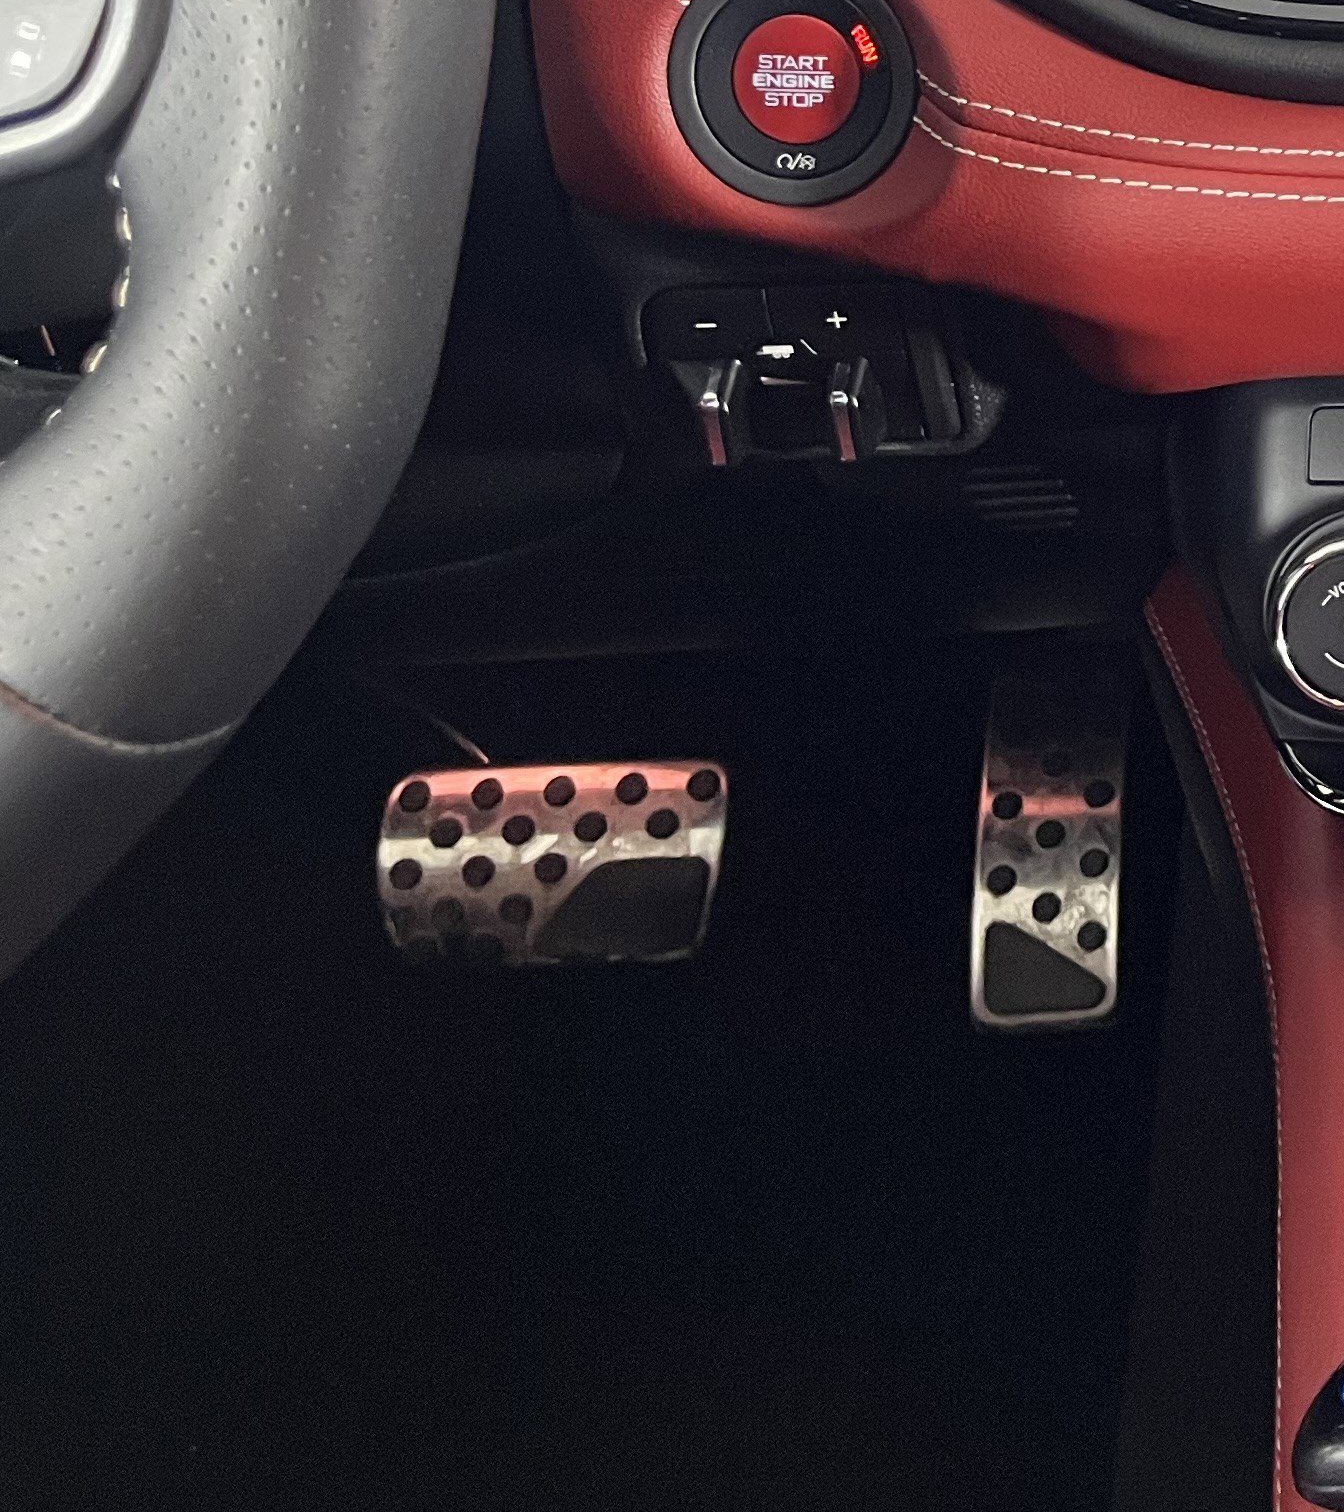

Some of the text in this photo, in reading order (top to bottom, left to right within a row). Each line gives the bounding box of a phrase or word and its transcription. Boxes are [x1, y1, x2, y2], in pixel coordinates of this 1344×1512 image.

[850, 23, 879, 62] RUN
[758, 54, 828, 70] START
[752, 73, 835, 89] ENGINE
[765, 92, 824, 107] STOP
